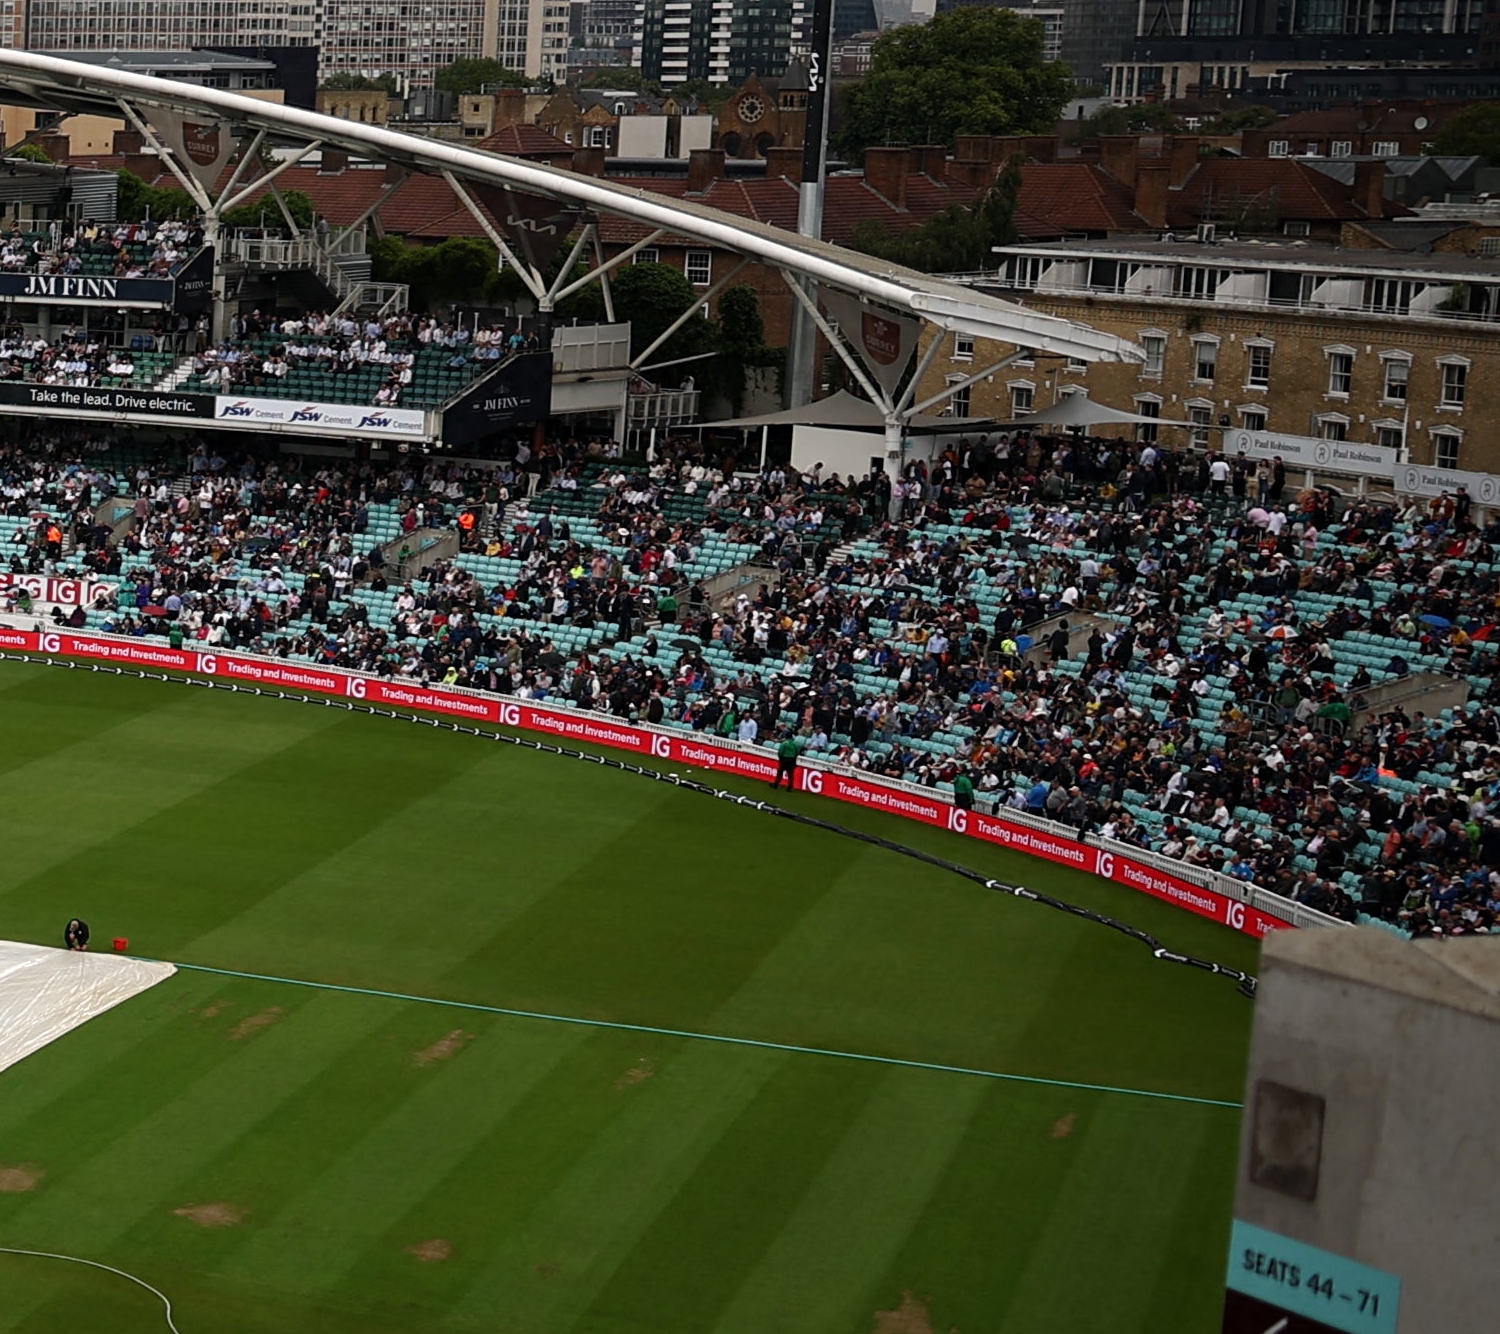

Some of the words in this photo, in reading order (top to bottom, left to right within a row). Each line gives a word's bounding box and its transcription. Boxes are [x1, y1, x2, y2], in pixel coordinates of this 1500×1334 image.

[24, 276, 55, 296] JM
[63, 277, 118, 298] FINN
[219, 401, 254, 417] JSW
[255, 410, 284, 419] Cement
[288, 406, 323, 422] JSW
[324, 415, 352, 425] Cement
[1254, 439, 1269, 448] Paul
[1270, 441, 1300, 453] Robinson
[1333, 450, 1348, 459] Paul
[1349, 451, 1382, 463] Robinson
[948, 806, 967, 832] IG
[978, 820, 1010, 841] Trading
[1012, 831, 1029, 845] and
[1030, 835, 1084, 862] investments
[1242, 1248, 1300, 1288] SEATS
[1307, 1273, 1334, 1301] 44
[1358, 1289, 1379, 1317] 71
